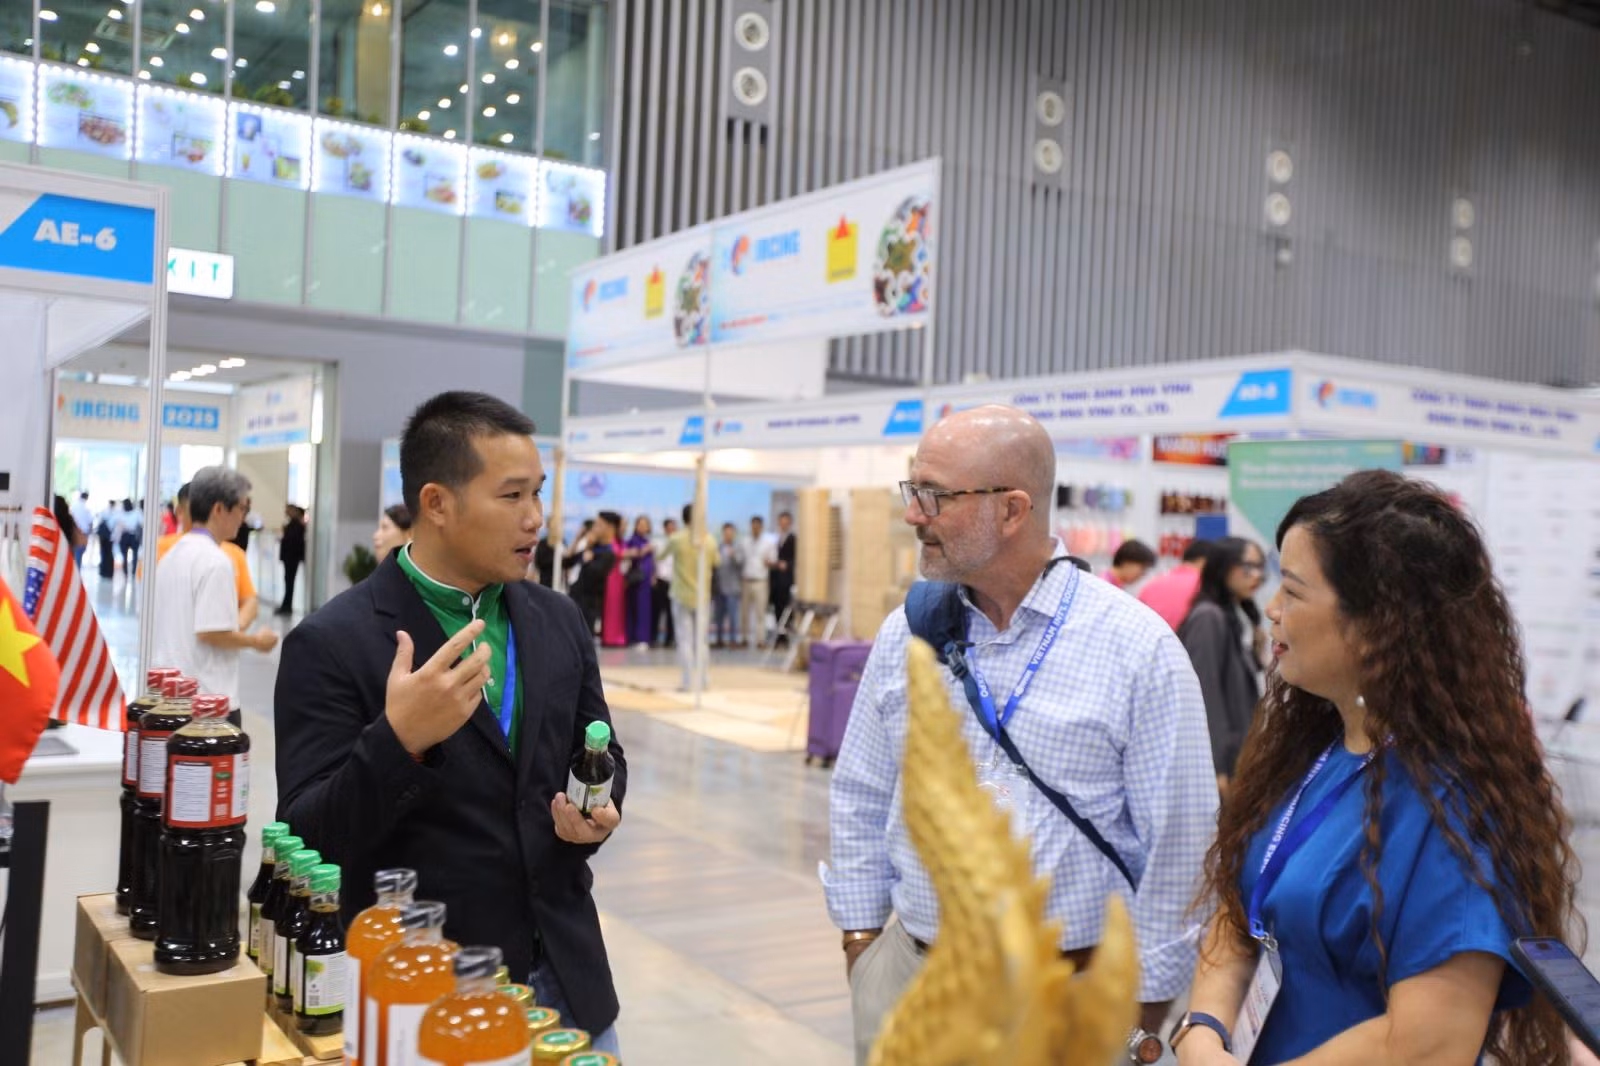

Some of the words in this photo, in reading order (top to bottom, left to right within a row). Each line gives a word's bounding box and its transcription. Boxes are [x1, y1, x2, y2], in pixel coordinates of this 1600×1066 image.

[34, 219, 117, 250] AE-6
[167, 257, 220, 282] XIT
[1031, 626, 1055, 665] VIETNAM
